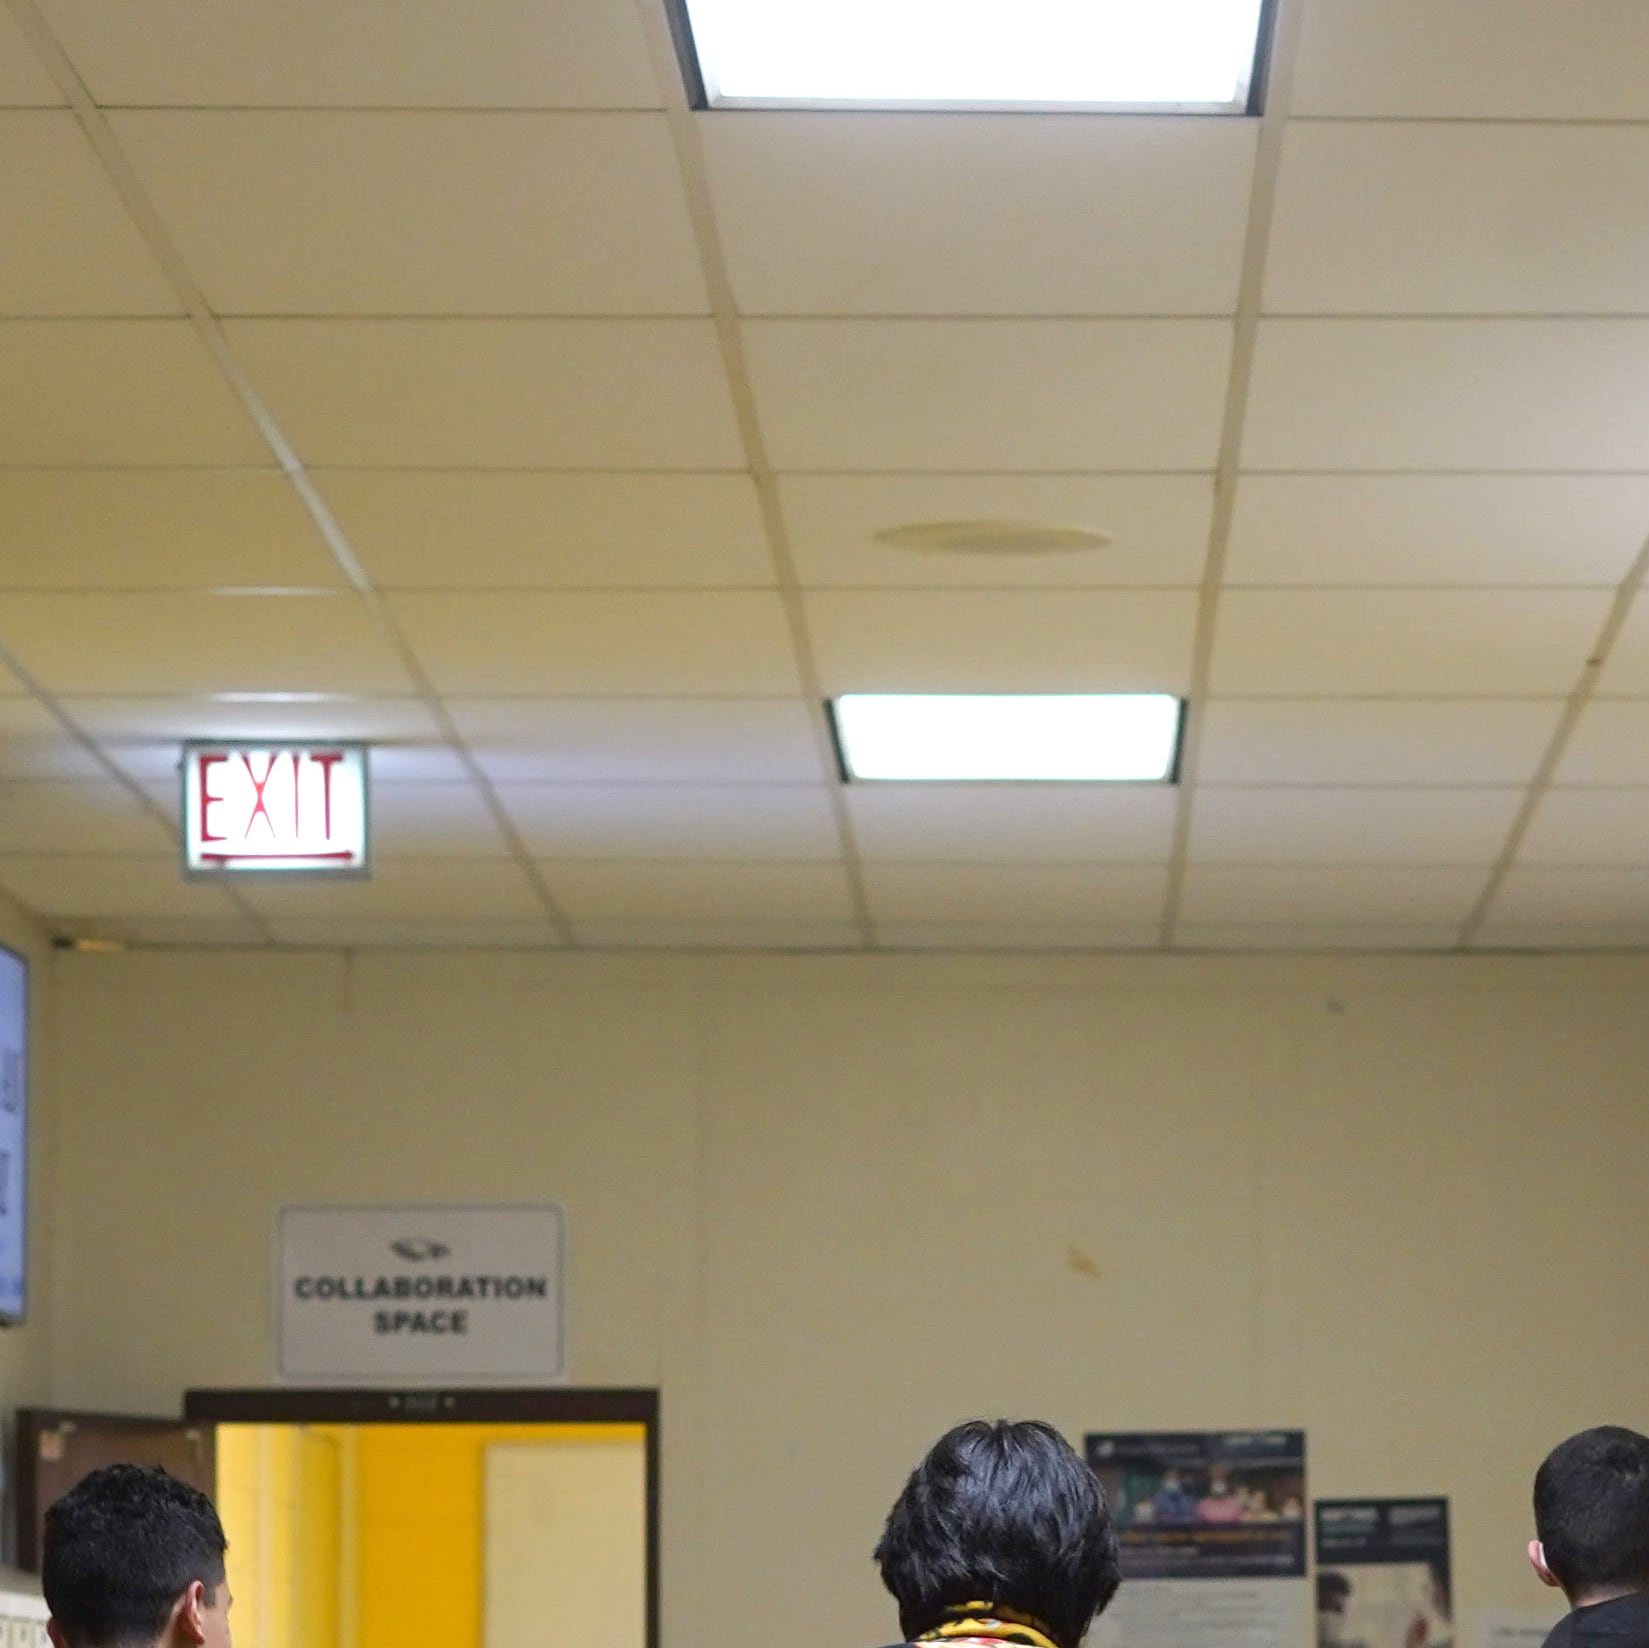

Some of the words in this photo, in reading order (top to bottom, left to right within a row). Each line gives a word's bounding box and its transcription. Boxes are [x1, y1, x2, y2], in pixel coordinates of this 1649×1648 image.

[198, 752, 344, 842] EXIT
[293, 1273, 548, 1300] COLLABORATION
[373, 1309, 469, 1335] SPACE
